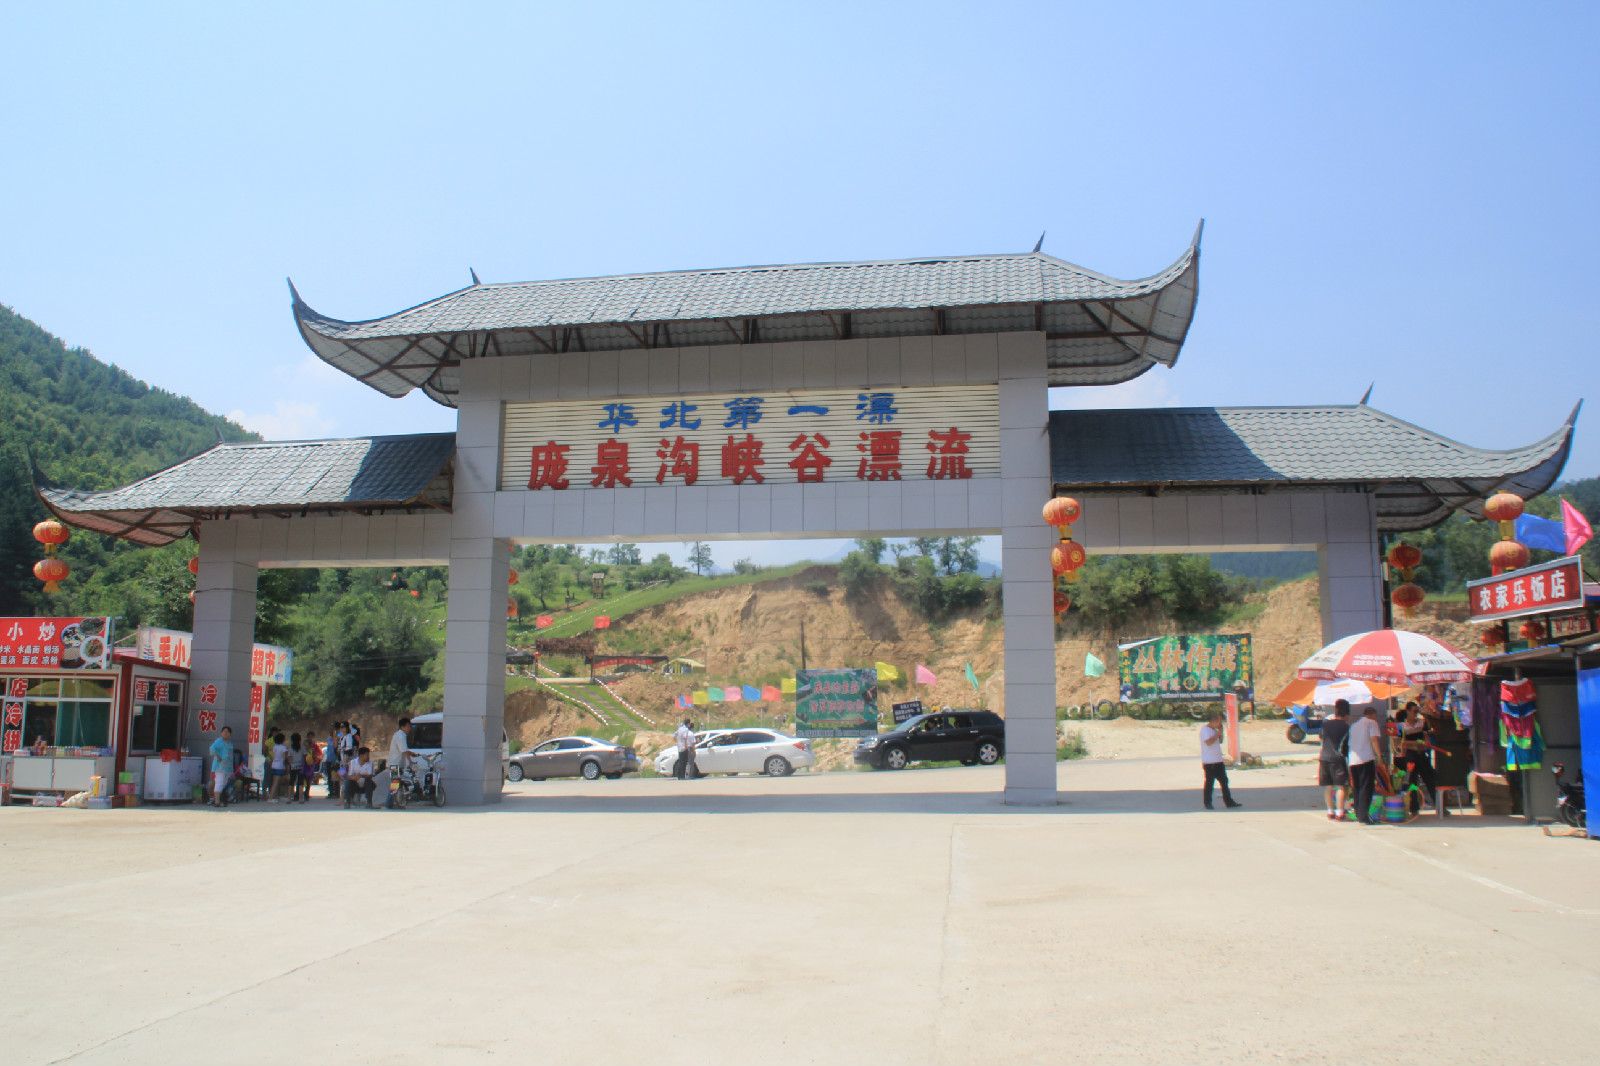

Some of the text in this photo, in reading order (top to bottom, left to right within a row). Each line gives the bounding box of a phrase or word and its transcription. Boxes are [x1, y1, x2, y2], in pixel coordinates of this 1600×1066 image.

[599, 393, 898, 433] 华北第一漂
[527, 427, 973, 490] 庞泉沟峡谷漂流
[1479, 570, 1566, 611] 农家乐饭店
[7, 622, 57, 642] 小炒
[252, 648, 276, 678] 超市
[1133, 642, 1237, 674] 丛林作战
[135, 680, 170, 703] 雪糕
[198, 683, 219, 733] 冷饮
